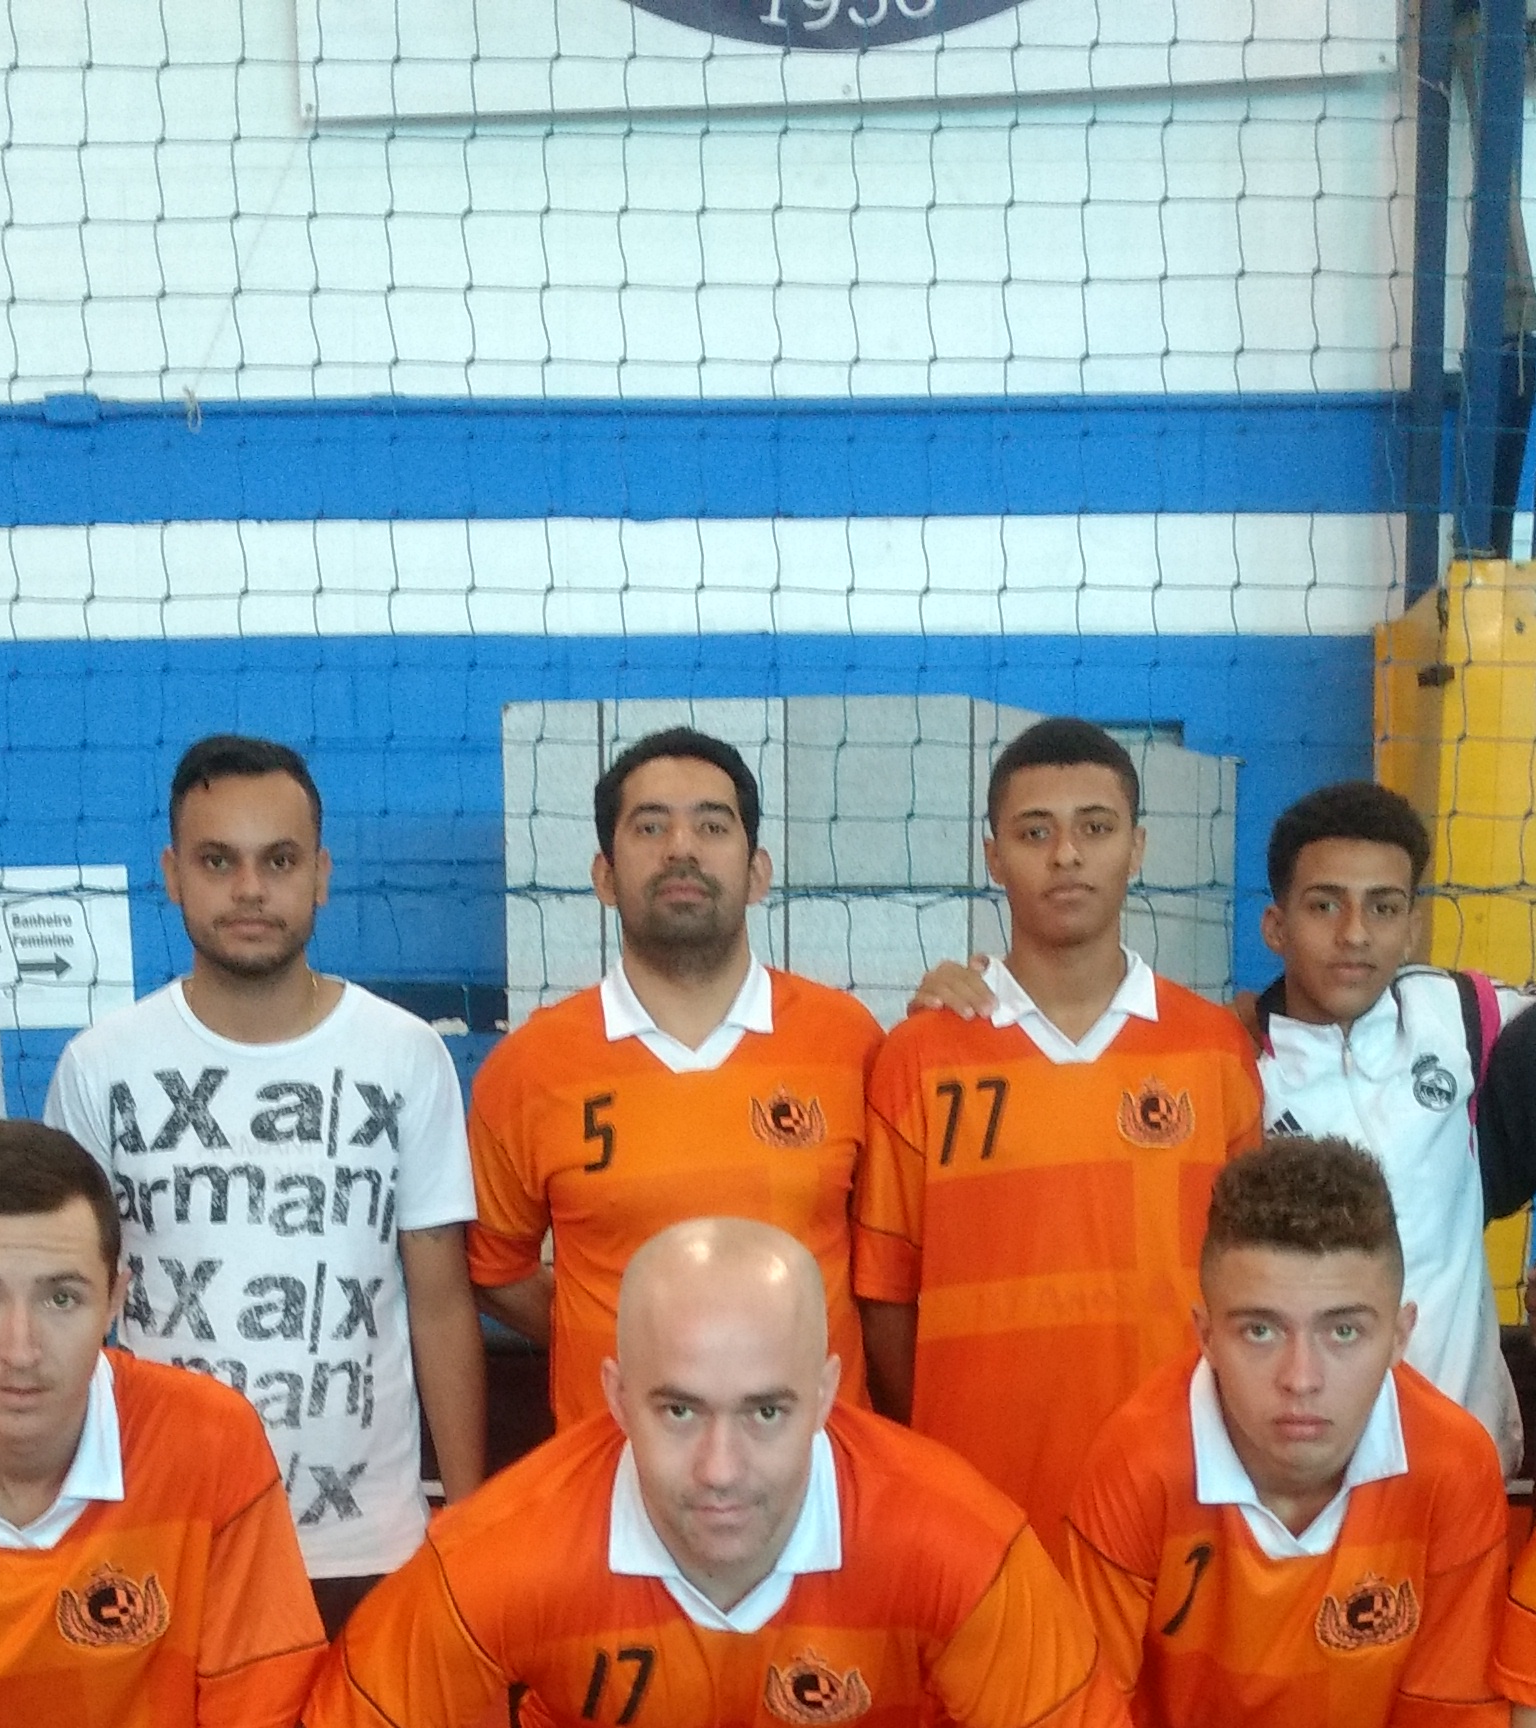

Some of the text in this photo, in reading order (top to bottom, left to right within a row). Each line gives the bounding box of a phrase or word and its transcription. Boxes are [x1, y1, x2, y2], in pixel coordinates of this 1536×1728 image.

[11, 913, 73, 928] Banheiro
[12, 932, 75, 948] Feminino
[582, 1093, 616, 1174] 5
[936, 1076, 1011, 1166] 77
[582, 1647, 657, 1728] 17
